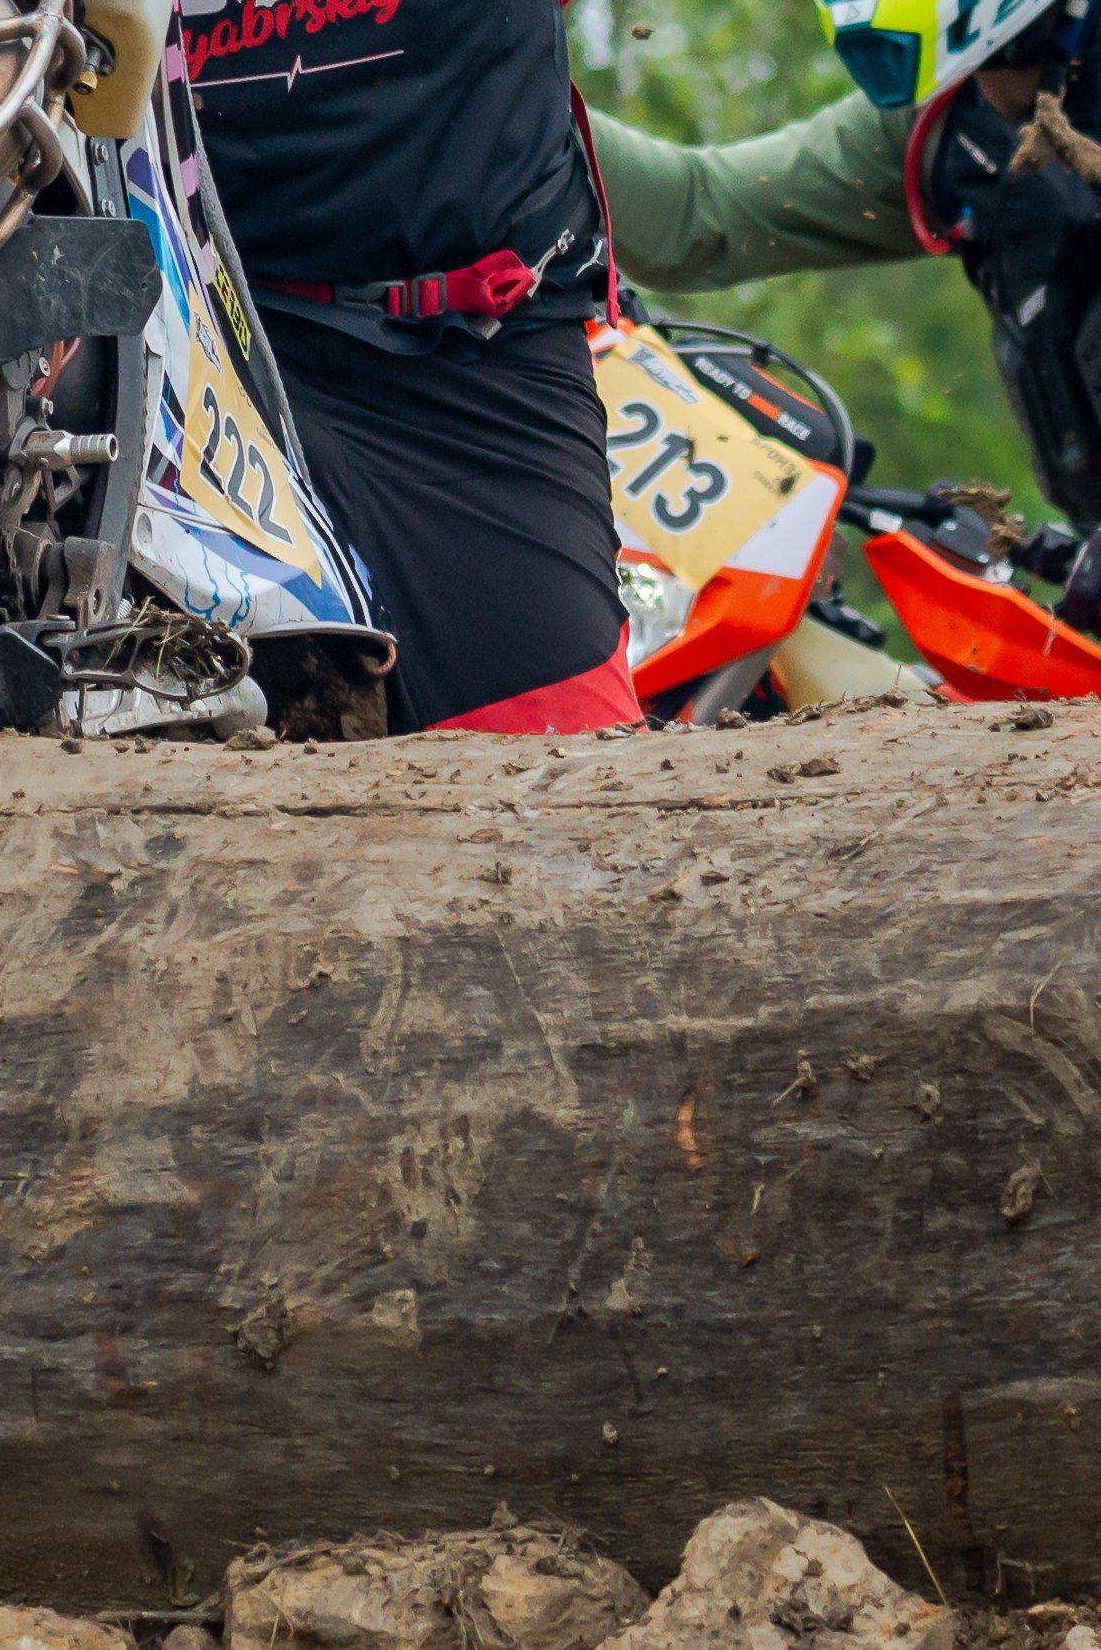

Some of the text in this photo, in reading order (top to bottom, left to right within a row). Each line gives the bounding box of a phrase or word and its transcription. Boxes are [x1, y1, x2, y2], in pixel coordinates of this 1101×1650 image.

[695, 356, 736, 388] READY
[731, 379, 752, 399] TO
[776, 411, 811, 441] RACE
[199, 383, 296, 548] 222
[607, 402, 728, 530] 213
